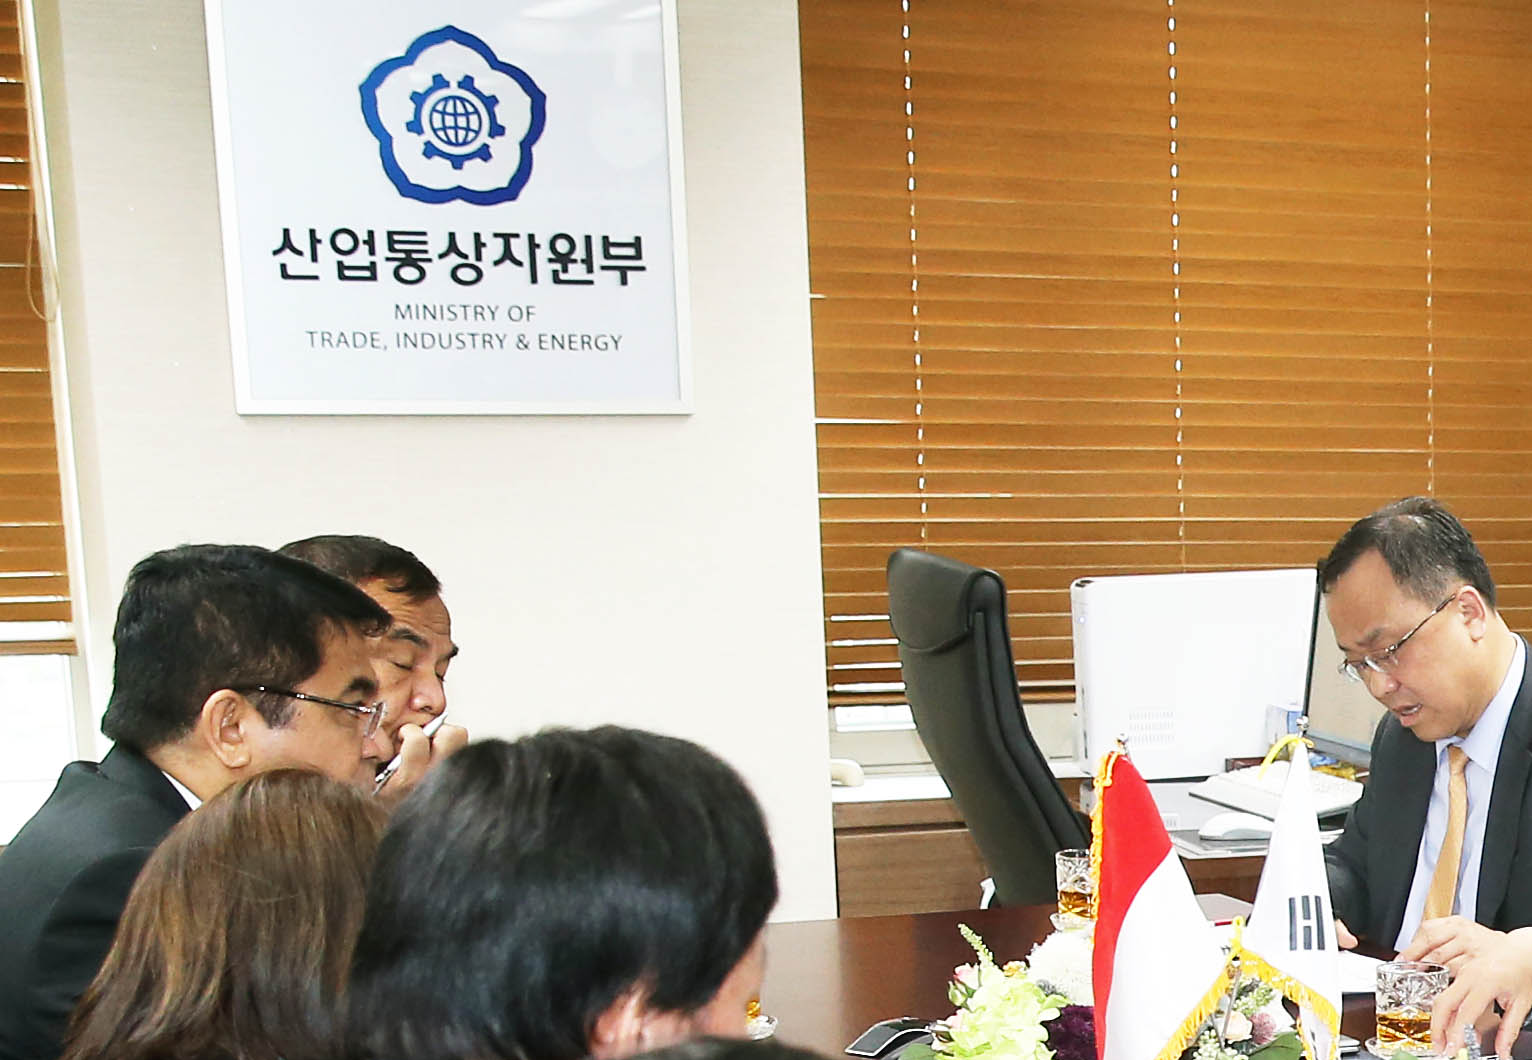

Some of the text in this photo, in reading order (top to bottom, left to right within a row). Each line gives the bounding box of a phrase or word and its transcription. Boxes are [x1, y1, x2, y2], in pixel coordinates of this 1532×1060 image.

[272, 227, 647, 286] 산업통상자원부
[394, 303, 537, 322] MINISTRY OF
[305, 330, 623, 351] TRADE, INDUSTRY & ENERGY
